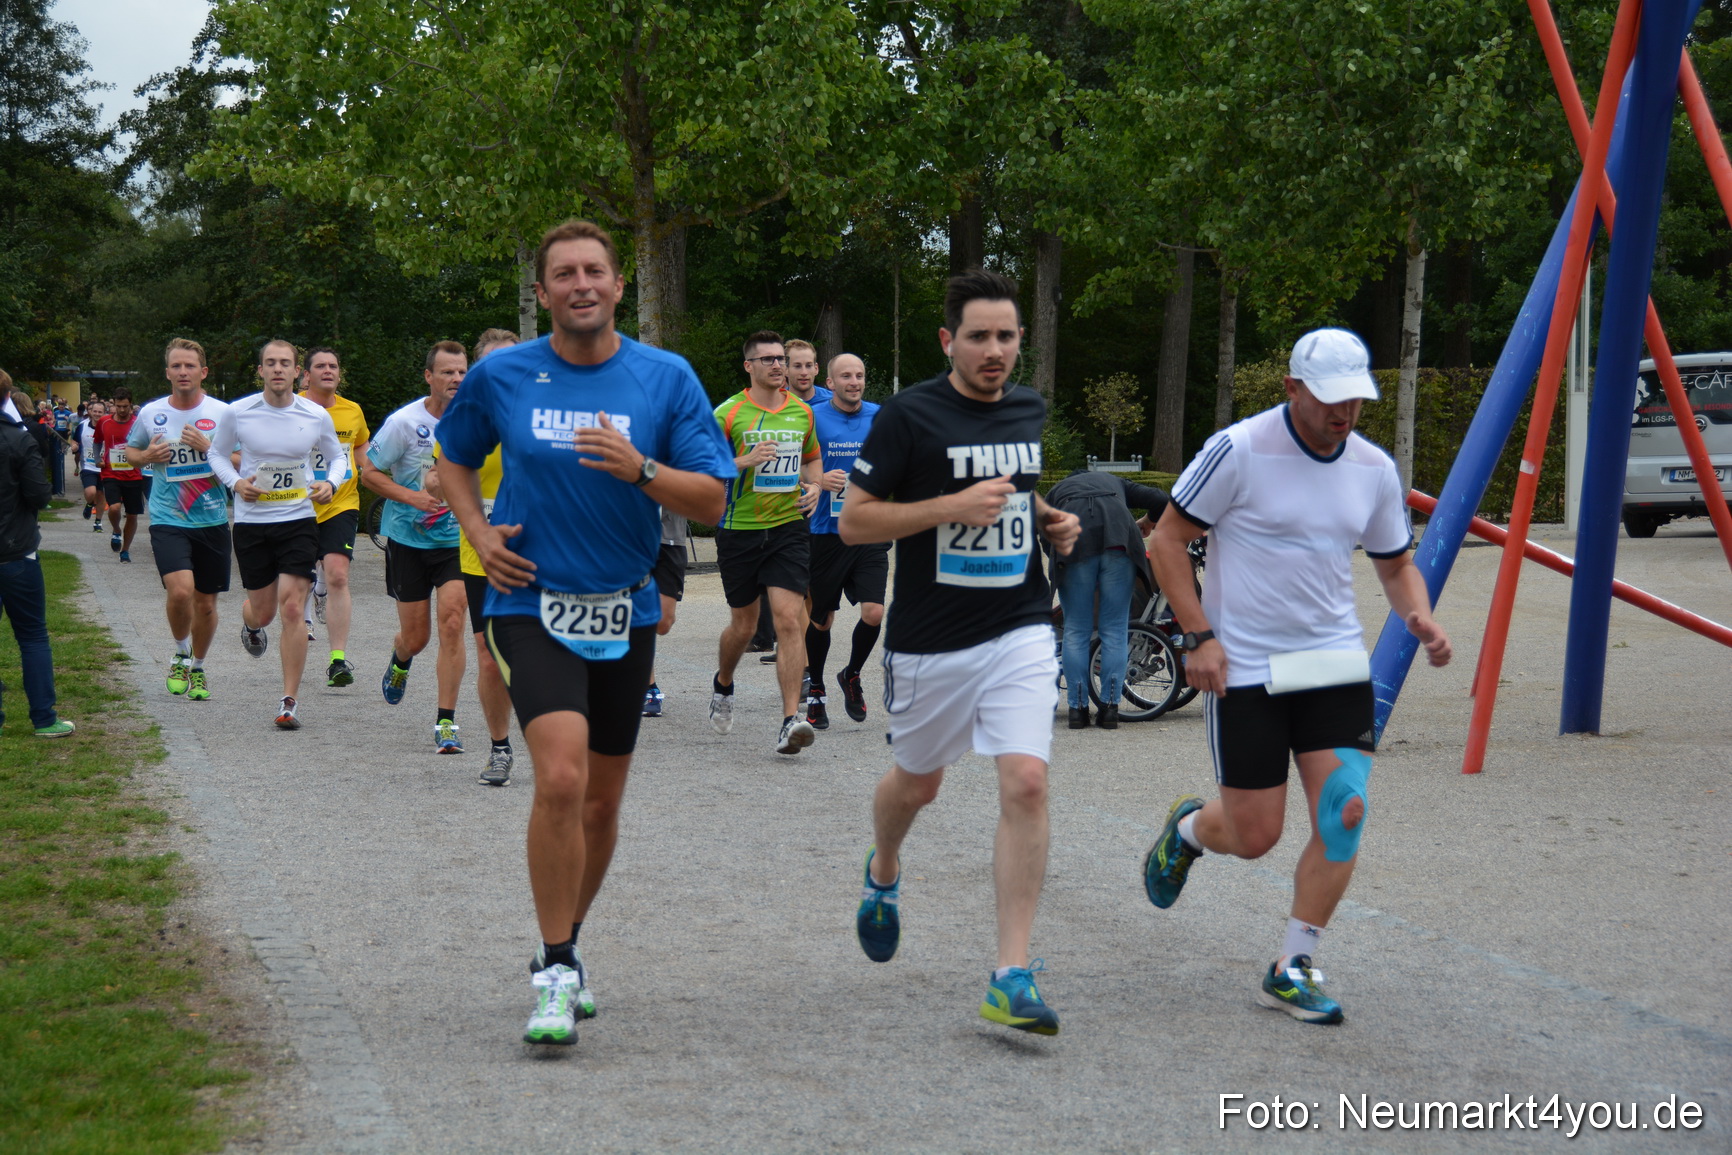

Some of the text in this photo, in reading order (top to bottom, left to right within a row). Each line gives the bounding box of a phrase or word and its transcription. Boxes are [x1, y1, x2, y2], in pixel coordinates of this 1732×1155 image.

[744, 430, 804, 444] BOCK
[175, 466, 205, 475] Christian
[761, 455, 799, 473] 2770
[273, 473, 293, 489] 26
[764, 477, 794, 486] Christoph
[266, 492, 298, 500] Sebastian
[949, 517, 1024, 551] 2219
[960, 560, 1013, 574] Joachim
[575, 594, 620, 603] Neumarkt
[548, 601, 629, 635] 2259
